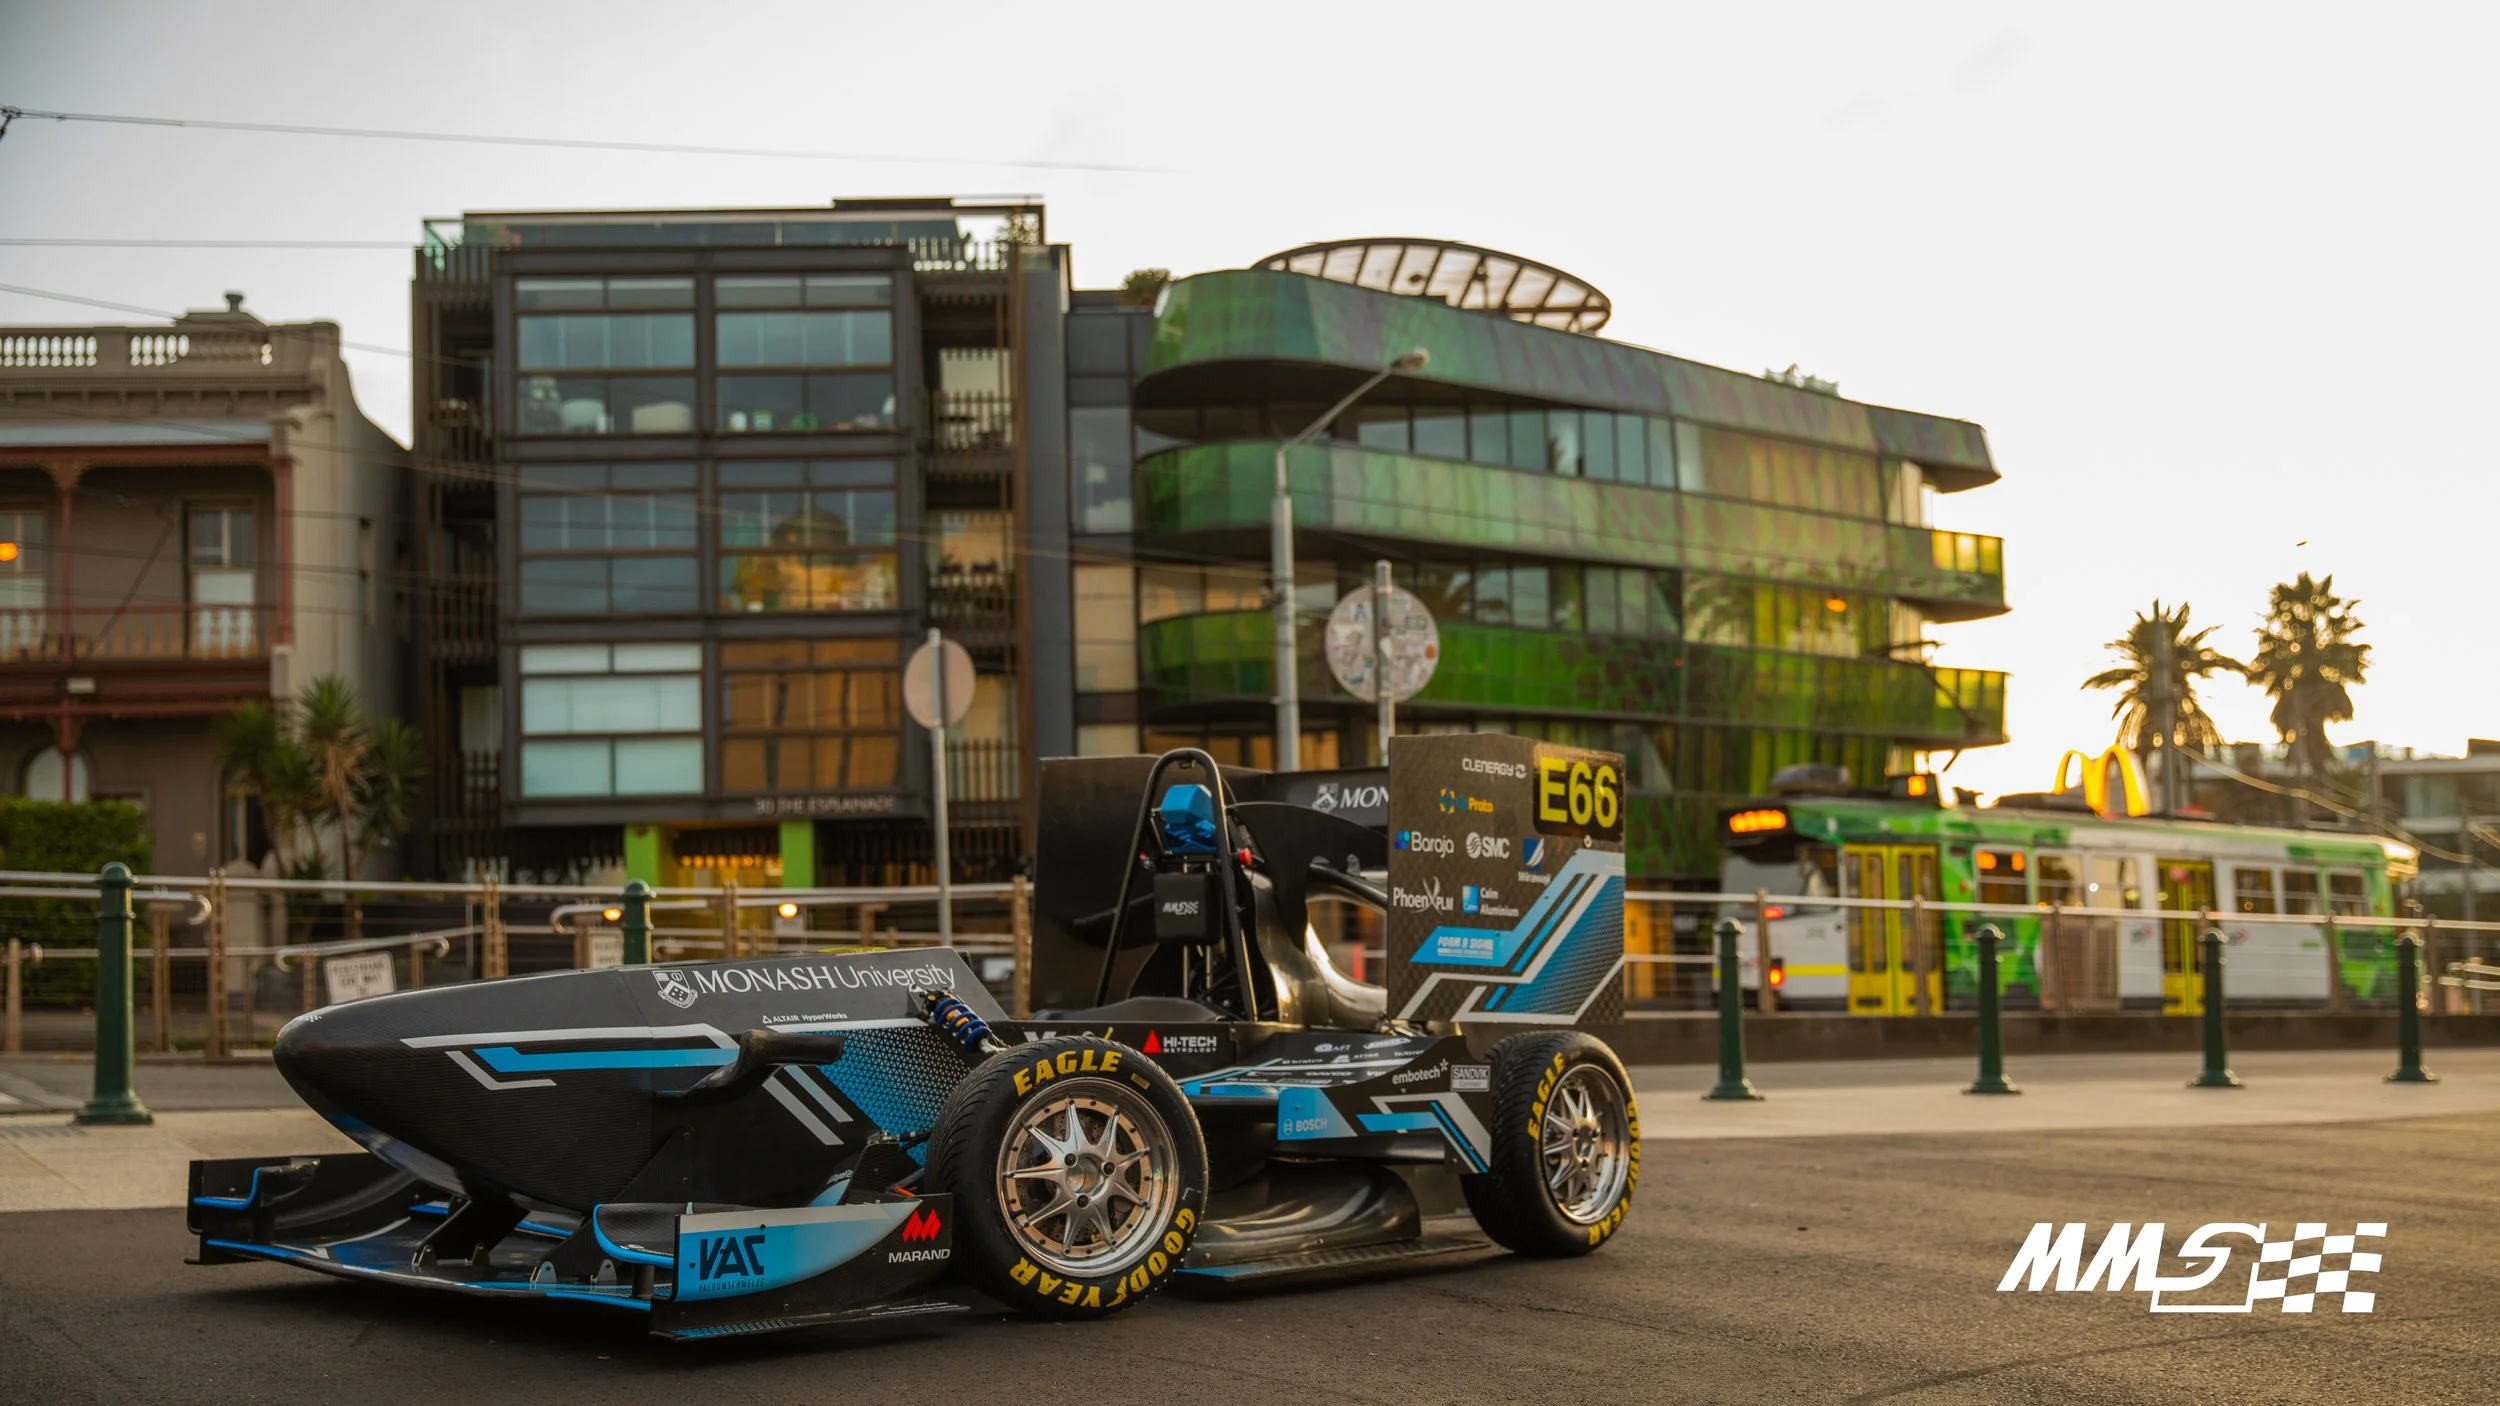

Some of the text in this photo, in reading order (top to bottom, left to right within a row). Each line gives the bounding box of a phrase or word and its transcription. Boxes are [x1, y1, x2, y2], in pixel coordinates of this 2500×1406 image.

[1462, 757, 1514, 777] CLENERGY
[1539, 756, 1618, 829] E66
[1481, 835, 1510, 859] SMC
[1480, 903, 1519, 917] Aluminium
[692, 963, 956, 994] MONASH University
[772, 1012, 847, 1024] ALTAIR HyperWorks
[1163, 1036, 1217, 1048] HI-TECH
[1012, 1049, 1123, 1097] EAGLE
[1392, 1064, 1441, 1086] embotech
[1451, 1066, 1489, 1080] SANDVIK
[1527, 1051, 1565, 1142] EAGLE
[1295, 1117, 1328, 1133] BOSCH
[700, 1234, 766, 1281] VAC
[888, 1248, 951, 1264] MARAND
[700, 1277, 765, 1293] VACUUMSCHMELZE
